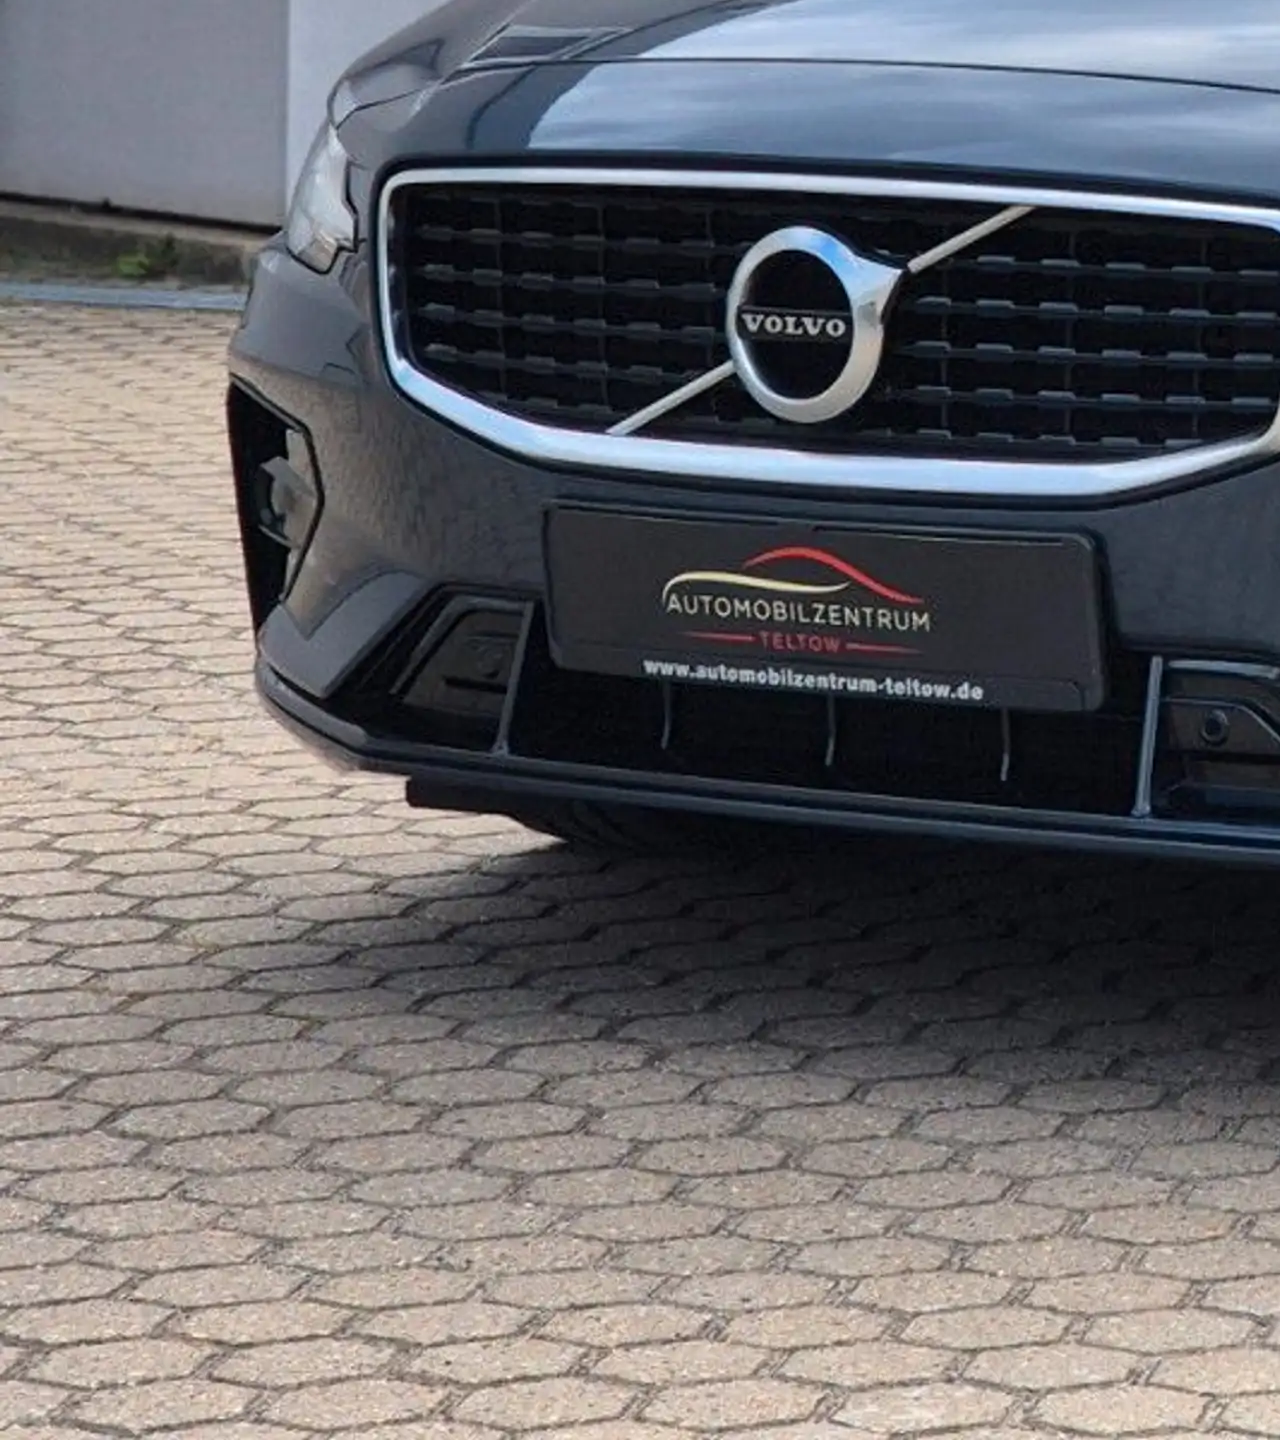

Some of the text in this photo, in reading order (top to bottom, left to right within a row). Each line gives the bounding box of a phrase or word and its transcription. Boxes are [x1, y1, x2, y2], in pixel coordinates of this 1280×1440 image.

[741, 313, 846, 337] VOLVO
[666, 593, 931, 633] AUTOMOBILZENTRUM
[760, 630, 840, 653] TELTOW
[643, 659, 984, 701] www.automobilzentrum-teltow.de
